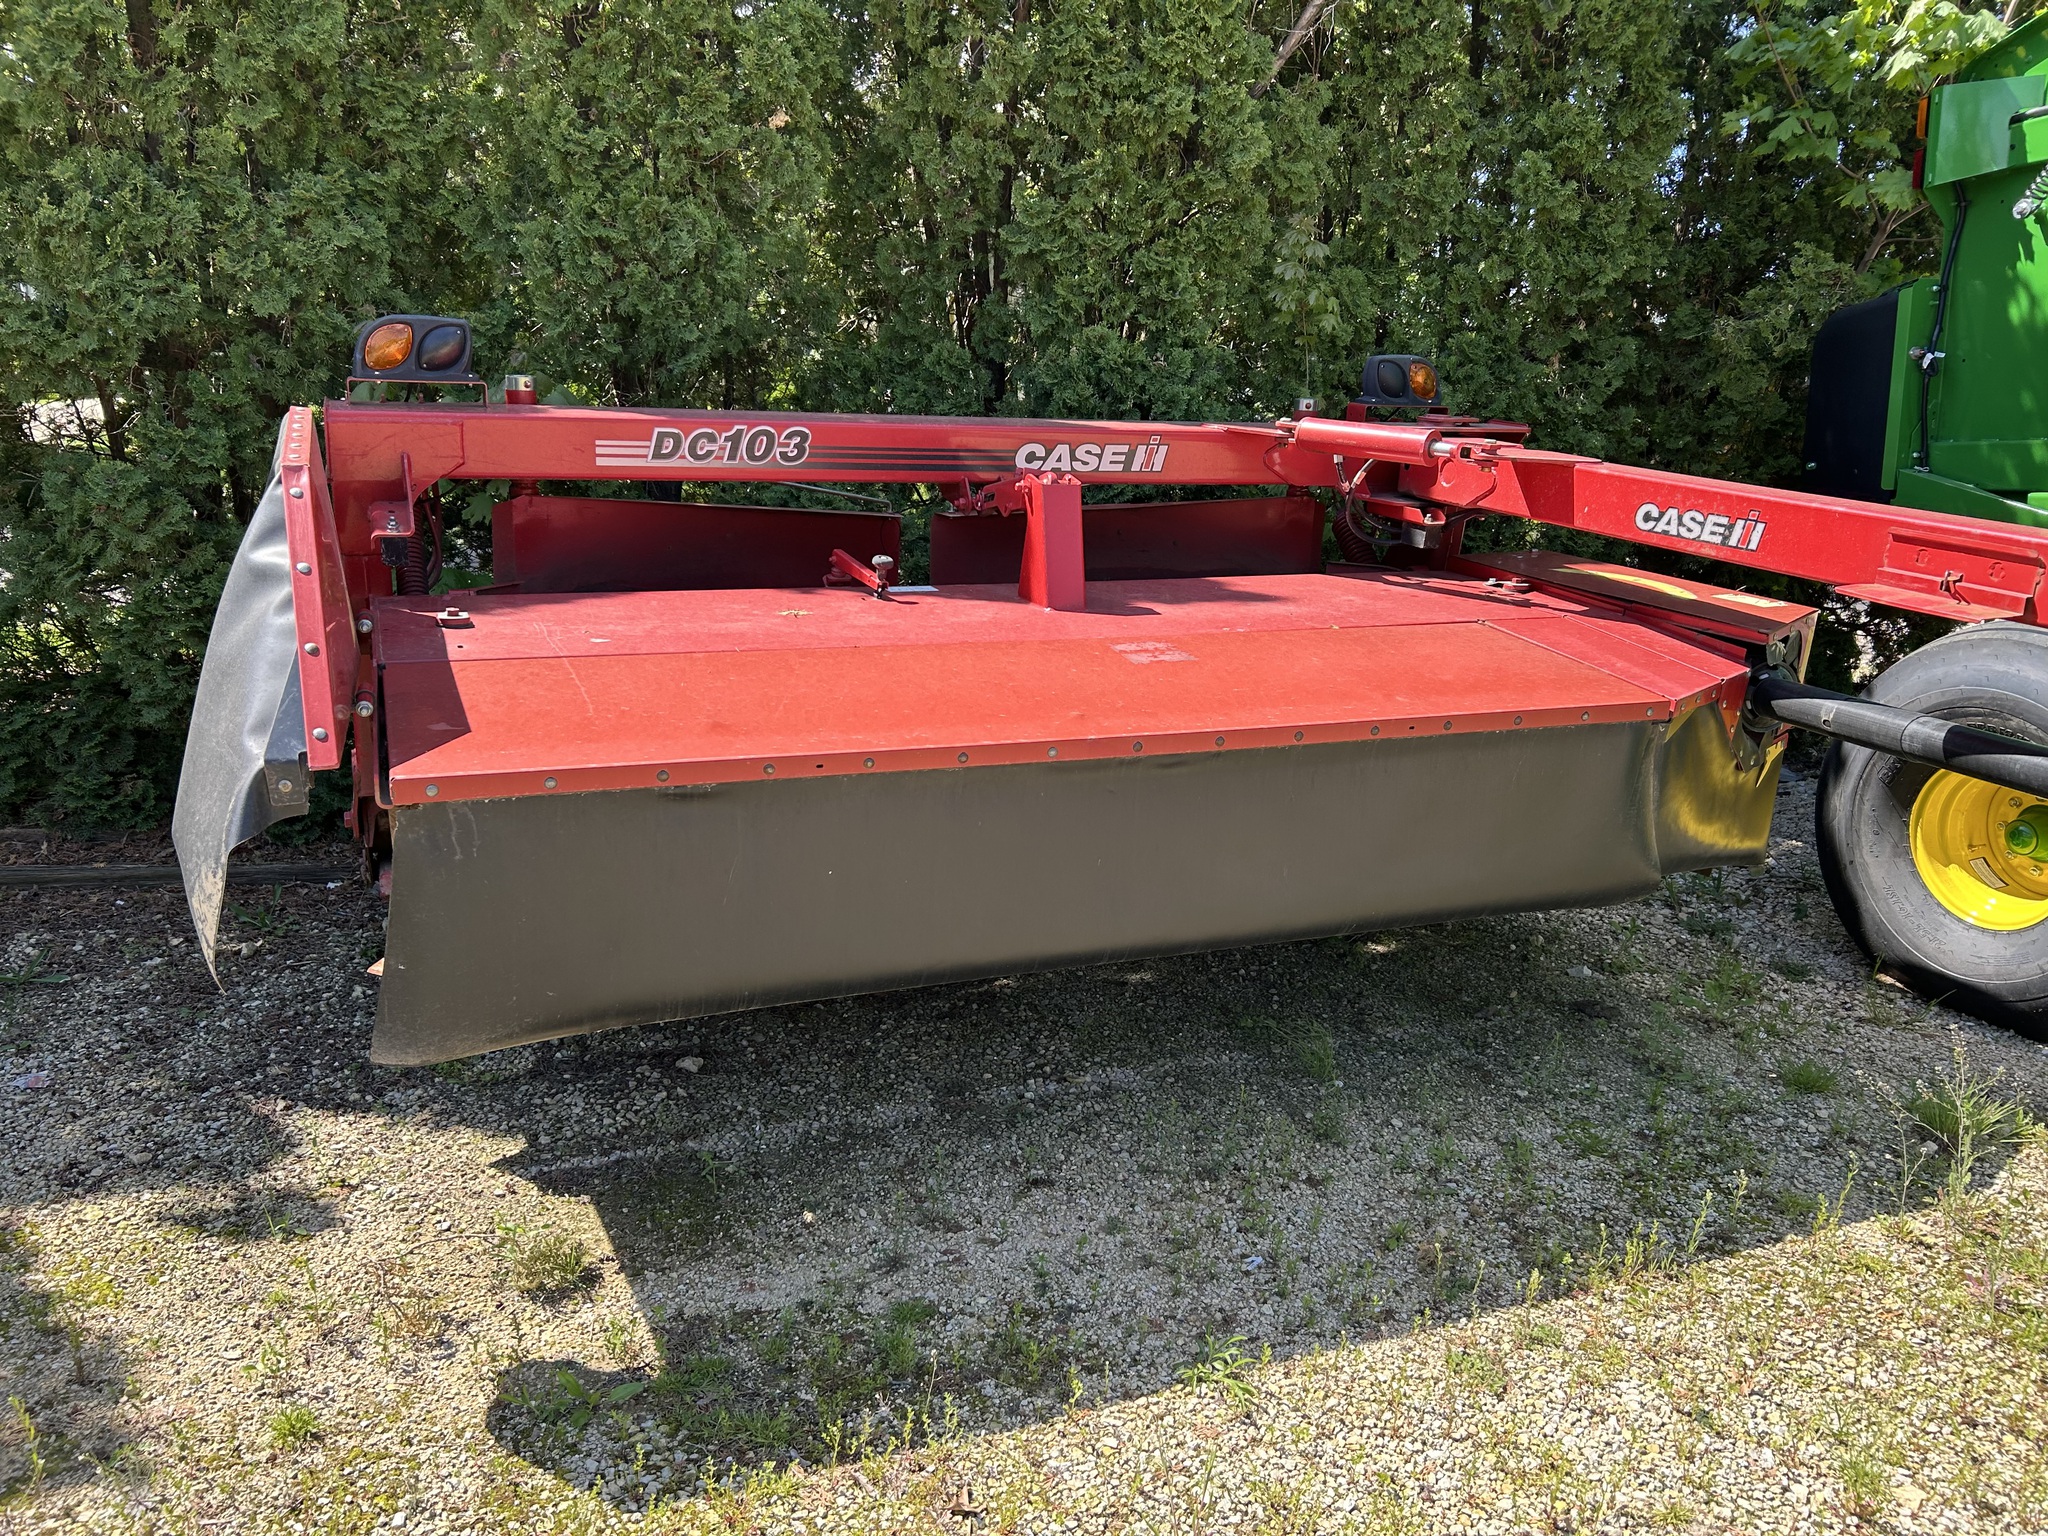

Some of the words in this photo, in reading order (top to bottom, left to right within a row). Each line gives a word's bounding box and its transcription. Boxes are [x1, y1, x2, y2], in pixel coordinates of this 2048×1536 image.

[647, 425, 811, 465] DC103
[1014, 442, 1130, 472] CASE
[1634, 502, 1730, 545] CASE
